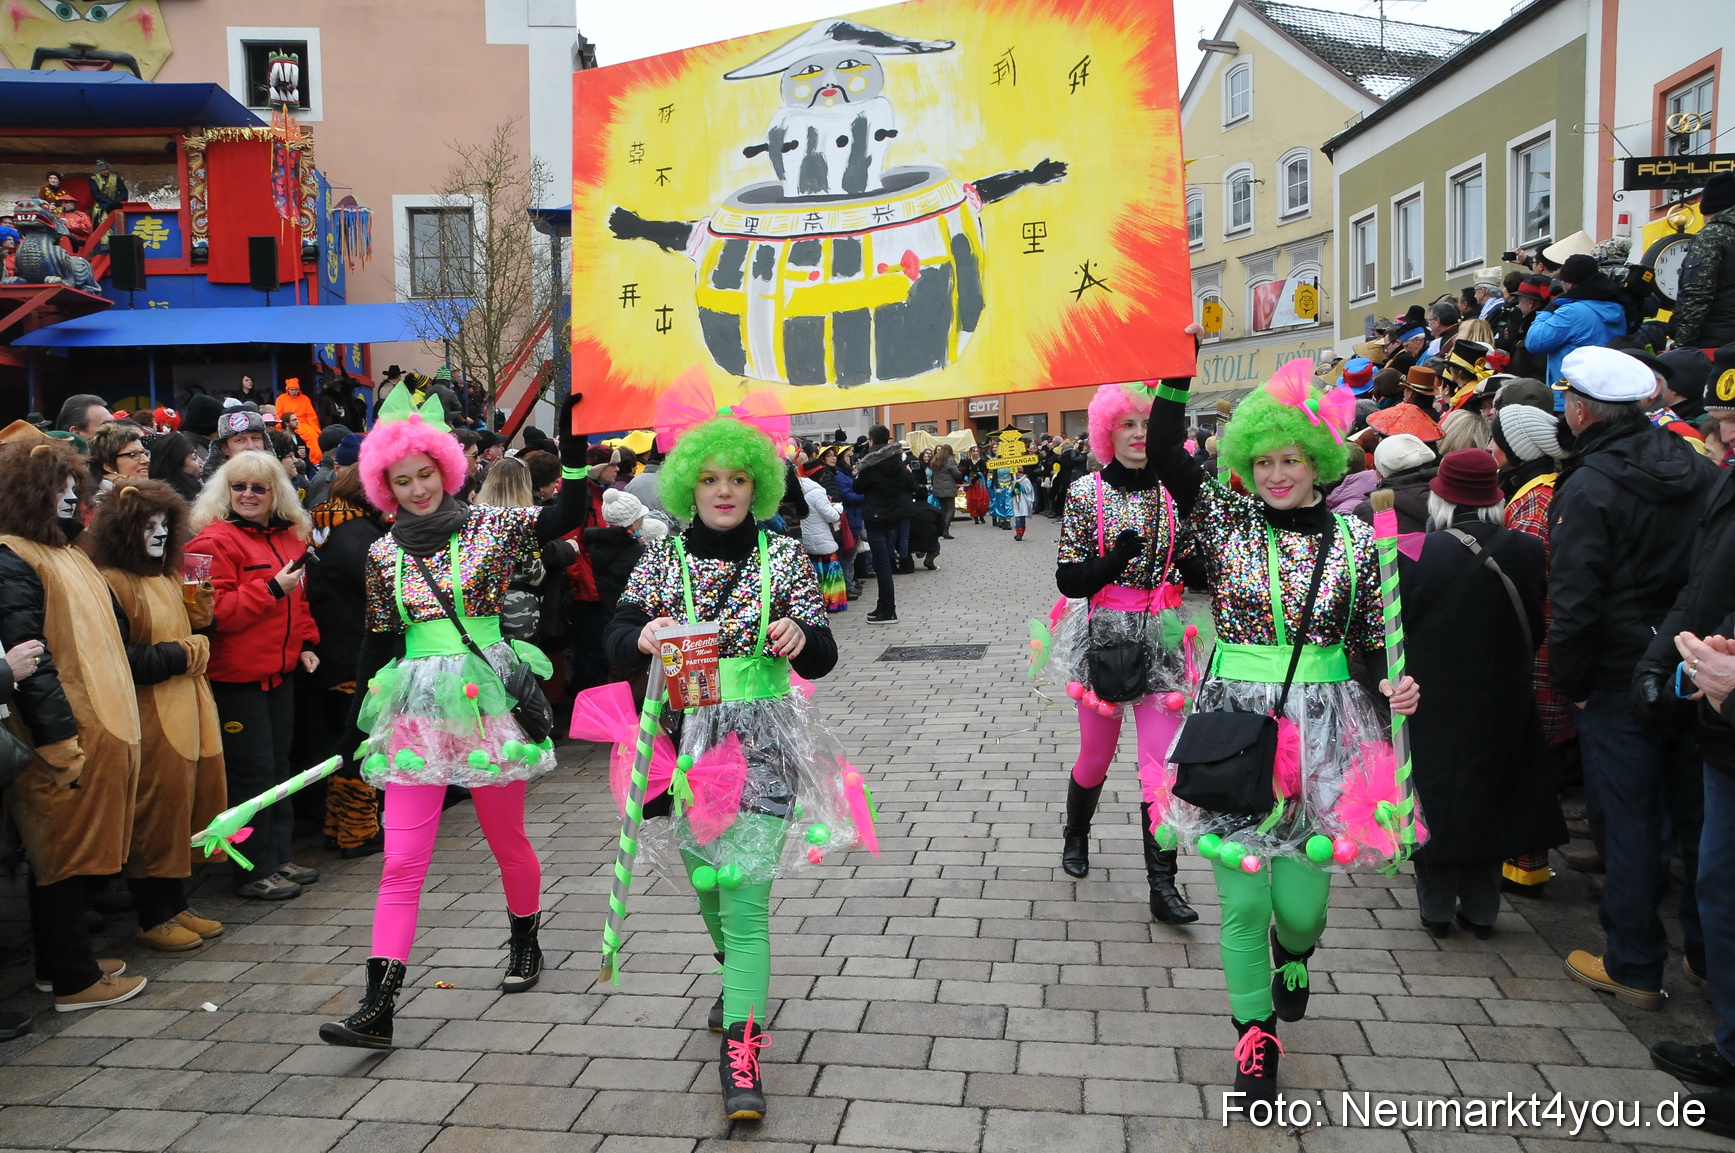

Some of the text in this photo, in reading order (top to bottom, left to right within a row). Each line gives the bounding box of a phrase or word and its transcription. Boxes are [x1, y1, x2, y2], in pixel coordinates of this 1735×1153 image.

[1201, 352, 1259, 386] STOLL
[969, 399, 999, 413] GÖTZ
[989, 456, 1037, 468] CHIMICHANGAS
